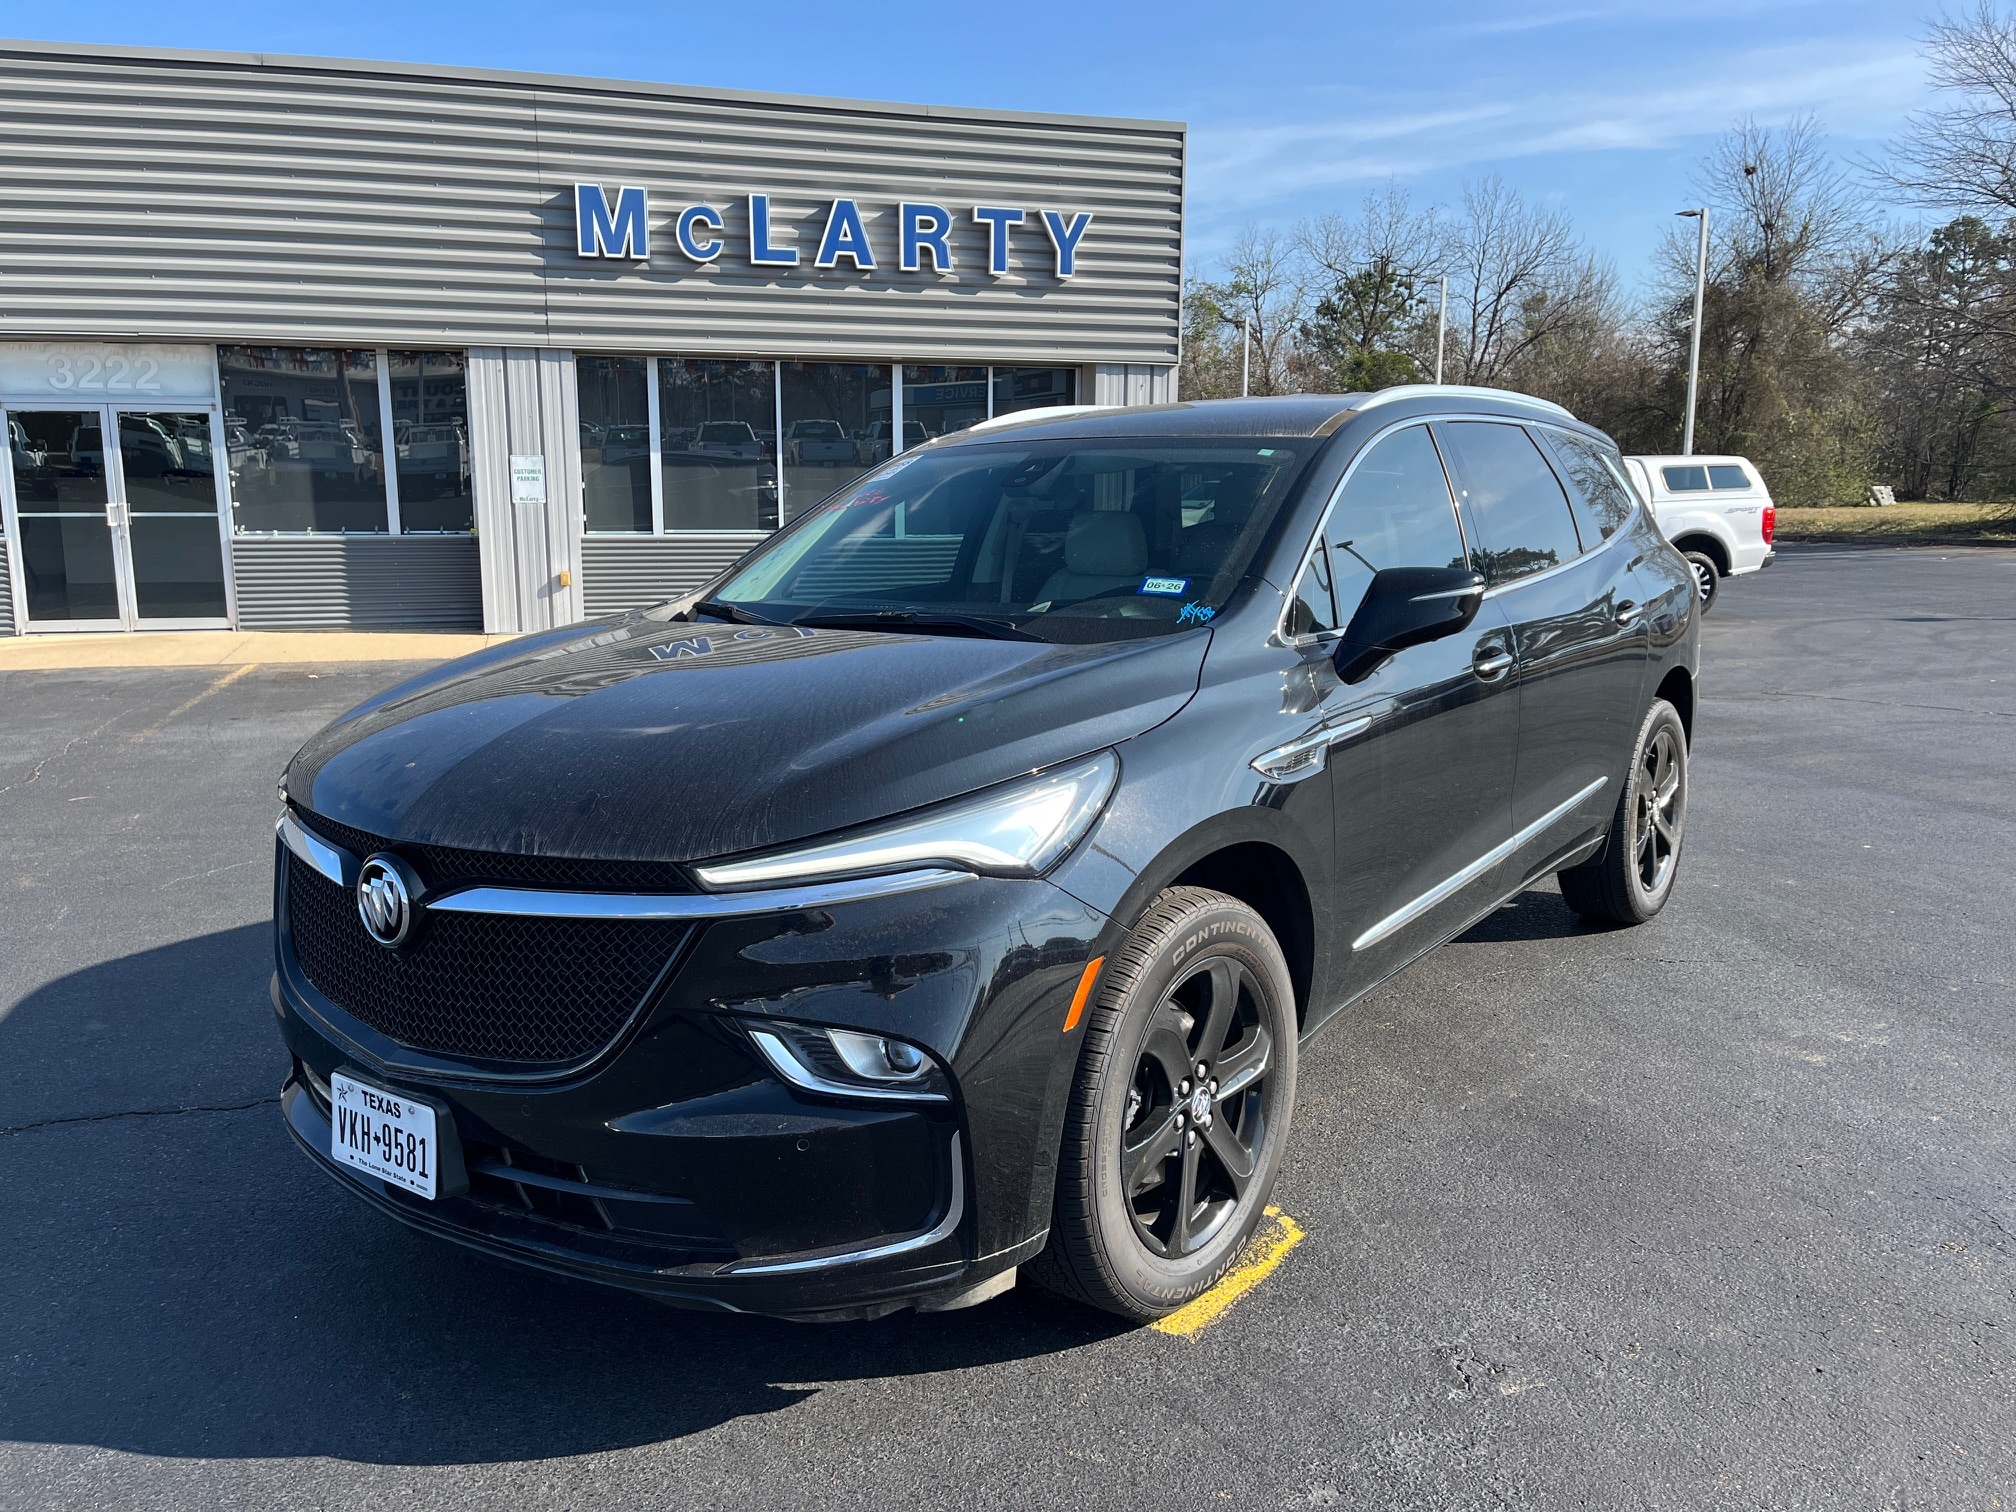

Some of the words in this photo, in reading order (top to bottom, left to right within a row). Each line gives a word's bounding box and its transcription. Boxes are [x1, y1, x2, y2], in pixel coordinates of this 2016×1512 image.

[47, 354, 161, 390] 3222
[1723, 506, 1761, 514] SPORT
[1173, 921, 1278, 967] CONTINENTAL
[361, 1089, 401, 1119] TEXAS
[358, 1157, 368, 1166] The
[368, 1160, 381, 1172] Lone
[381, 1166, 392, 1177] Star
[393, 1171, 407, 1183] State
